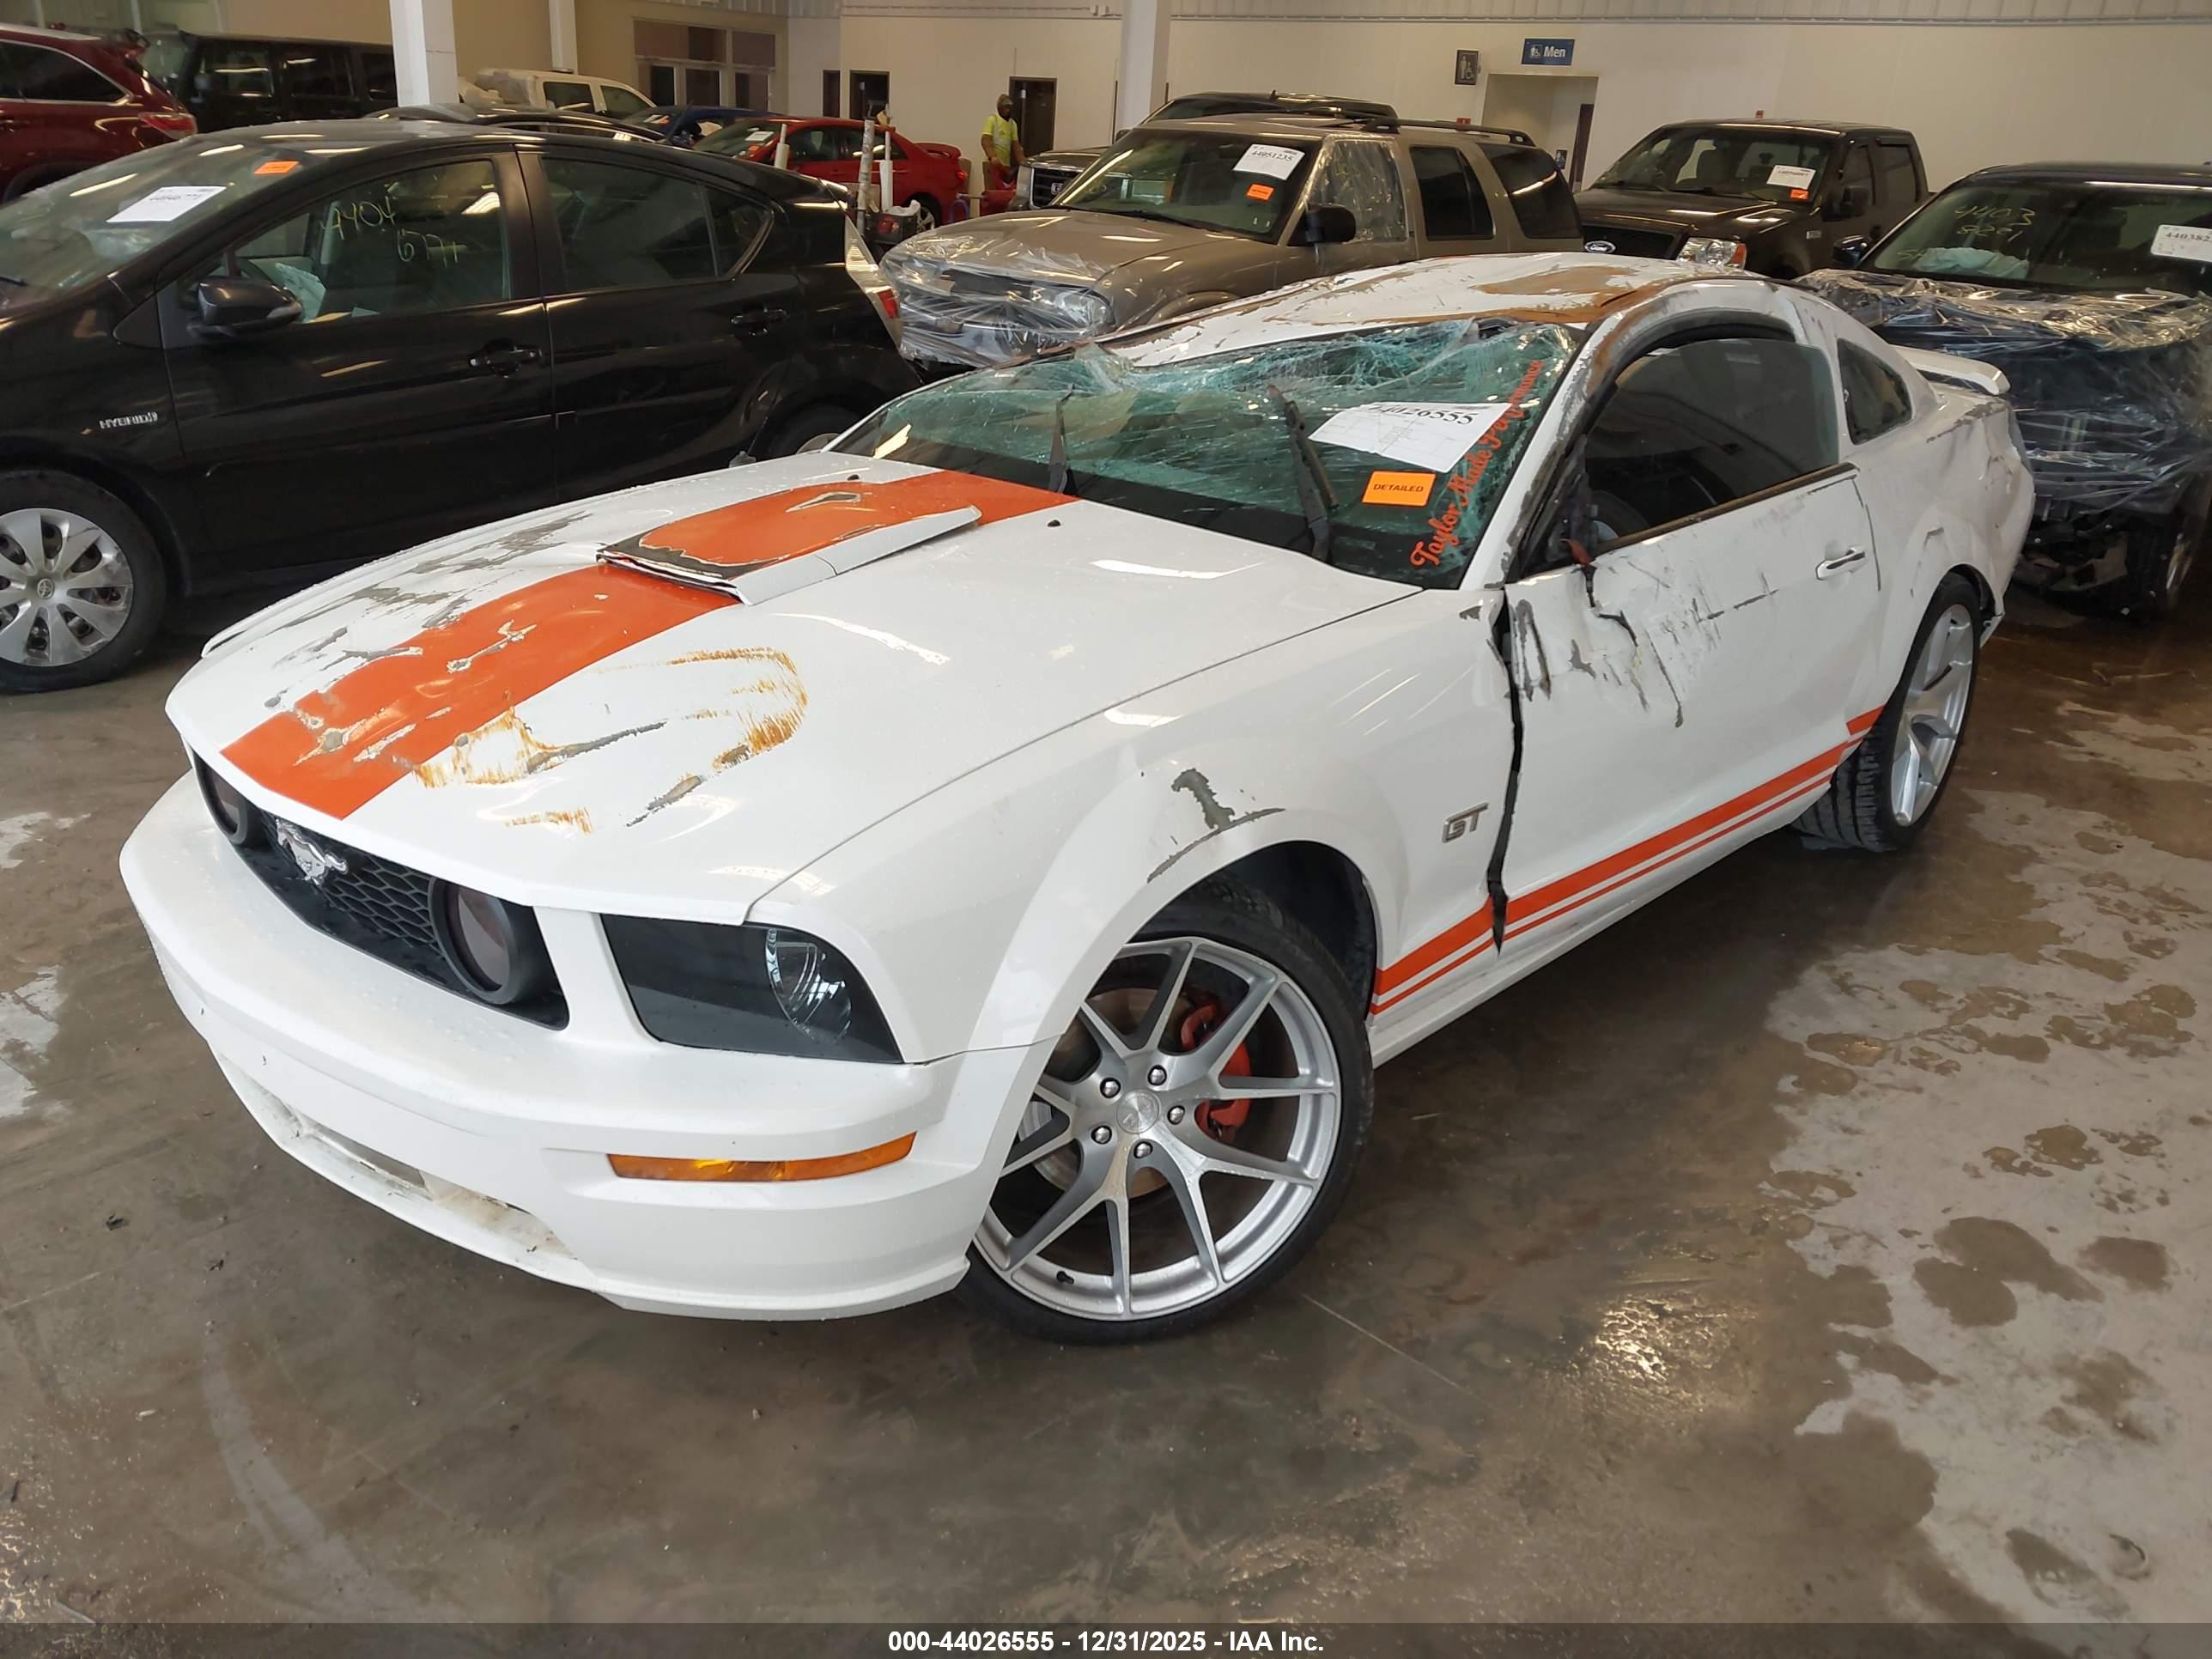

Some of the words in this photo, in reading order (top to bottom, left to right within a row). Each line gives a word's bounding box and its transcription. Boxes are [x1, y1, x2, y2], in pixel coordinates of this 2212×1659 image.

[1544, 46, 1566, 58] Men
[1373, 483, 1425, 493] DETAILED
[1410, 502, 1462, 567] Taylor
[1447, 448, 1492, 507] Made
[1442, 802, 1490, 843] GT
